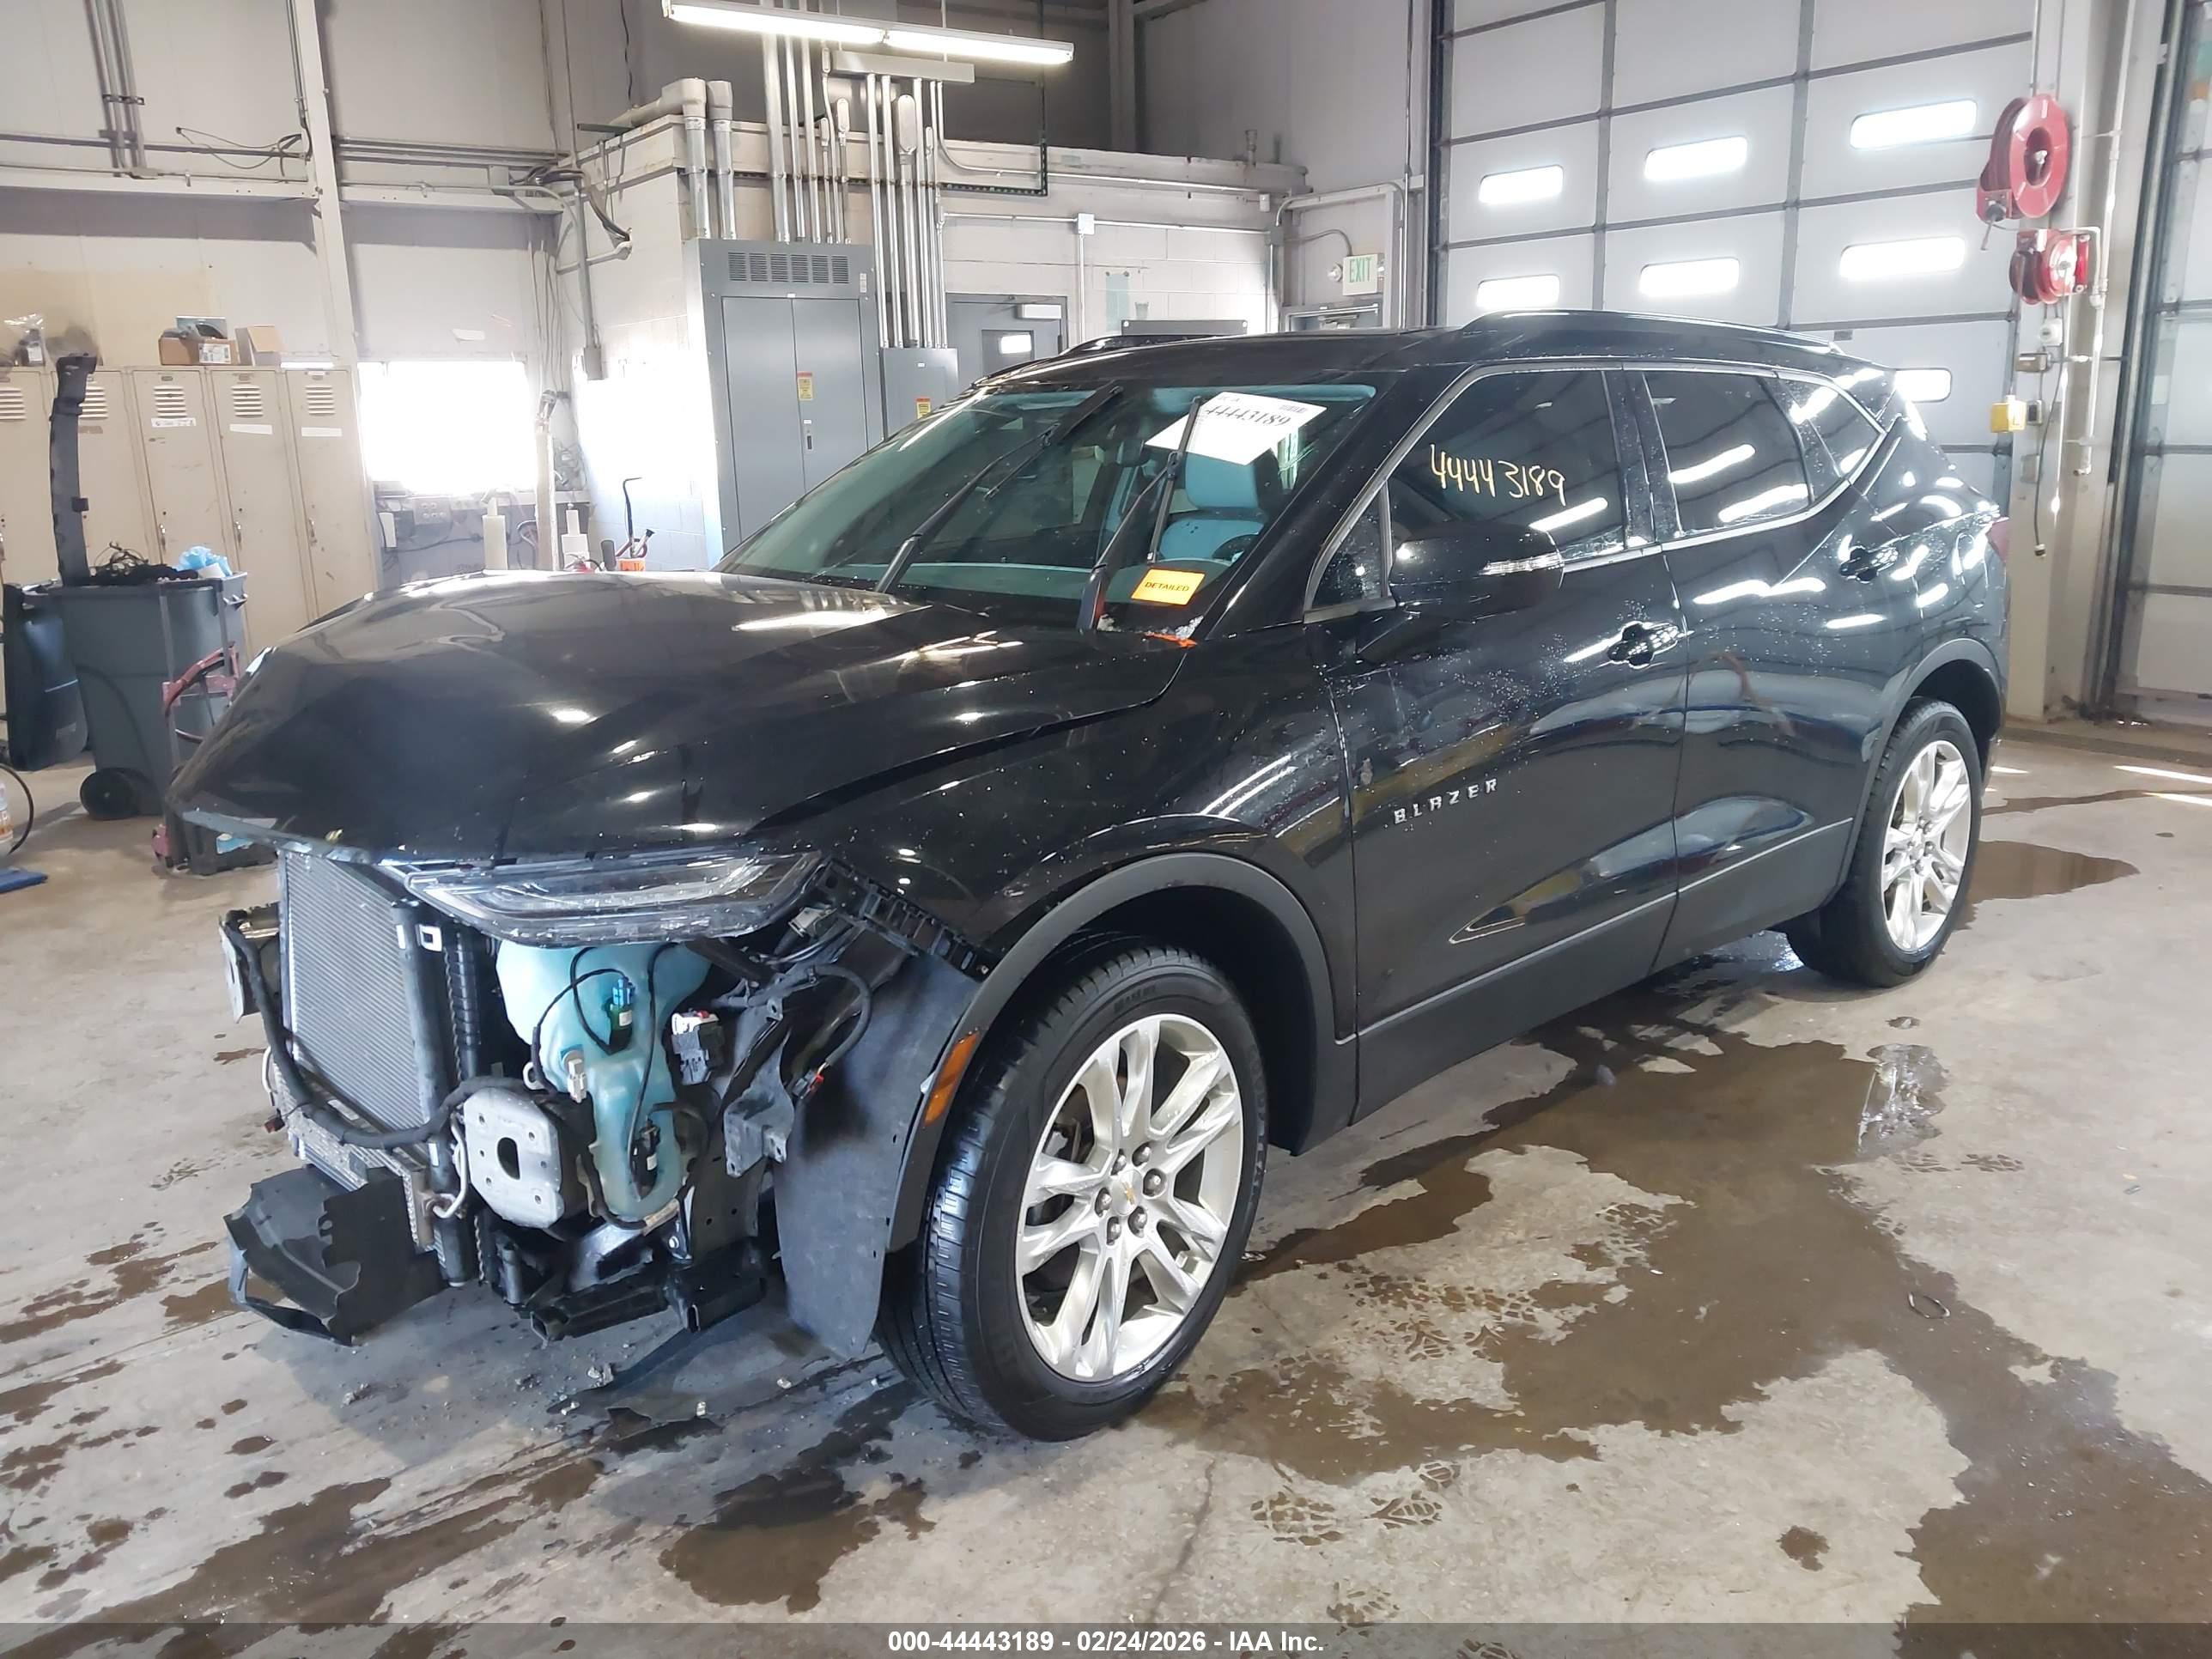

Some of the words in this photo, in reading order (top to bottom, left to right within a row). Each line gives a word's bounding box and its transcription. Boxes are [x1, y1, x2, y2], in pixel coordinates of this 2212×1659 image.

[1349, 257, 1371, 283] EXIT
[1204, 404, 1291, 427] 44443189
[1145, 581, 1190, 592] DETAILED
[1394, 778, 1498, 825] BLAZER
